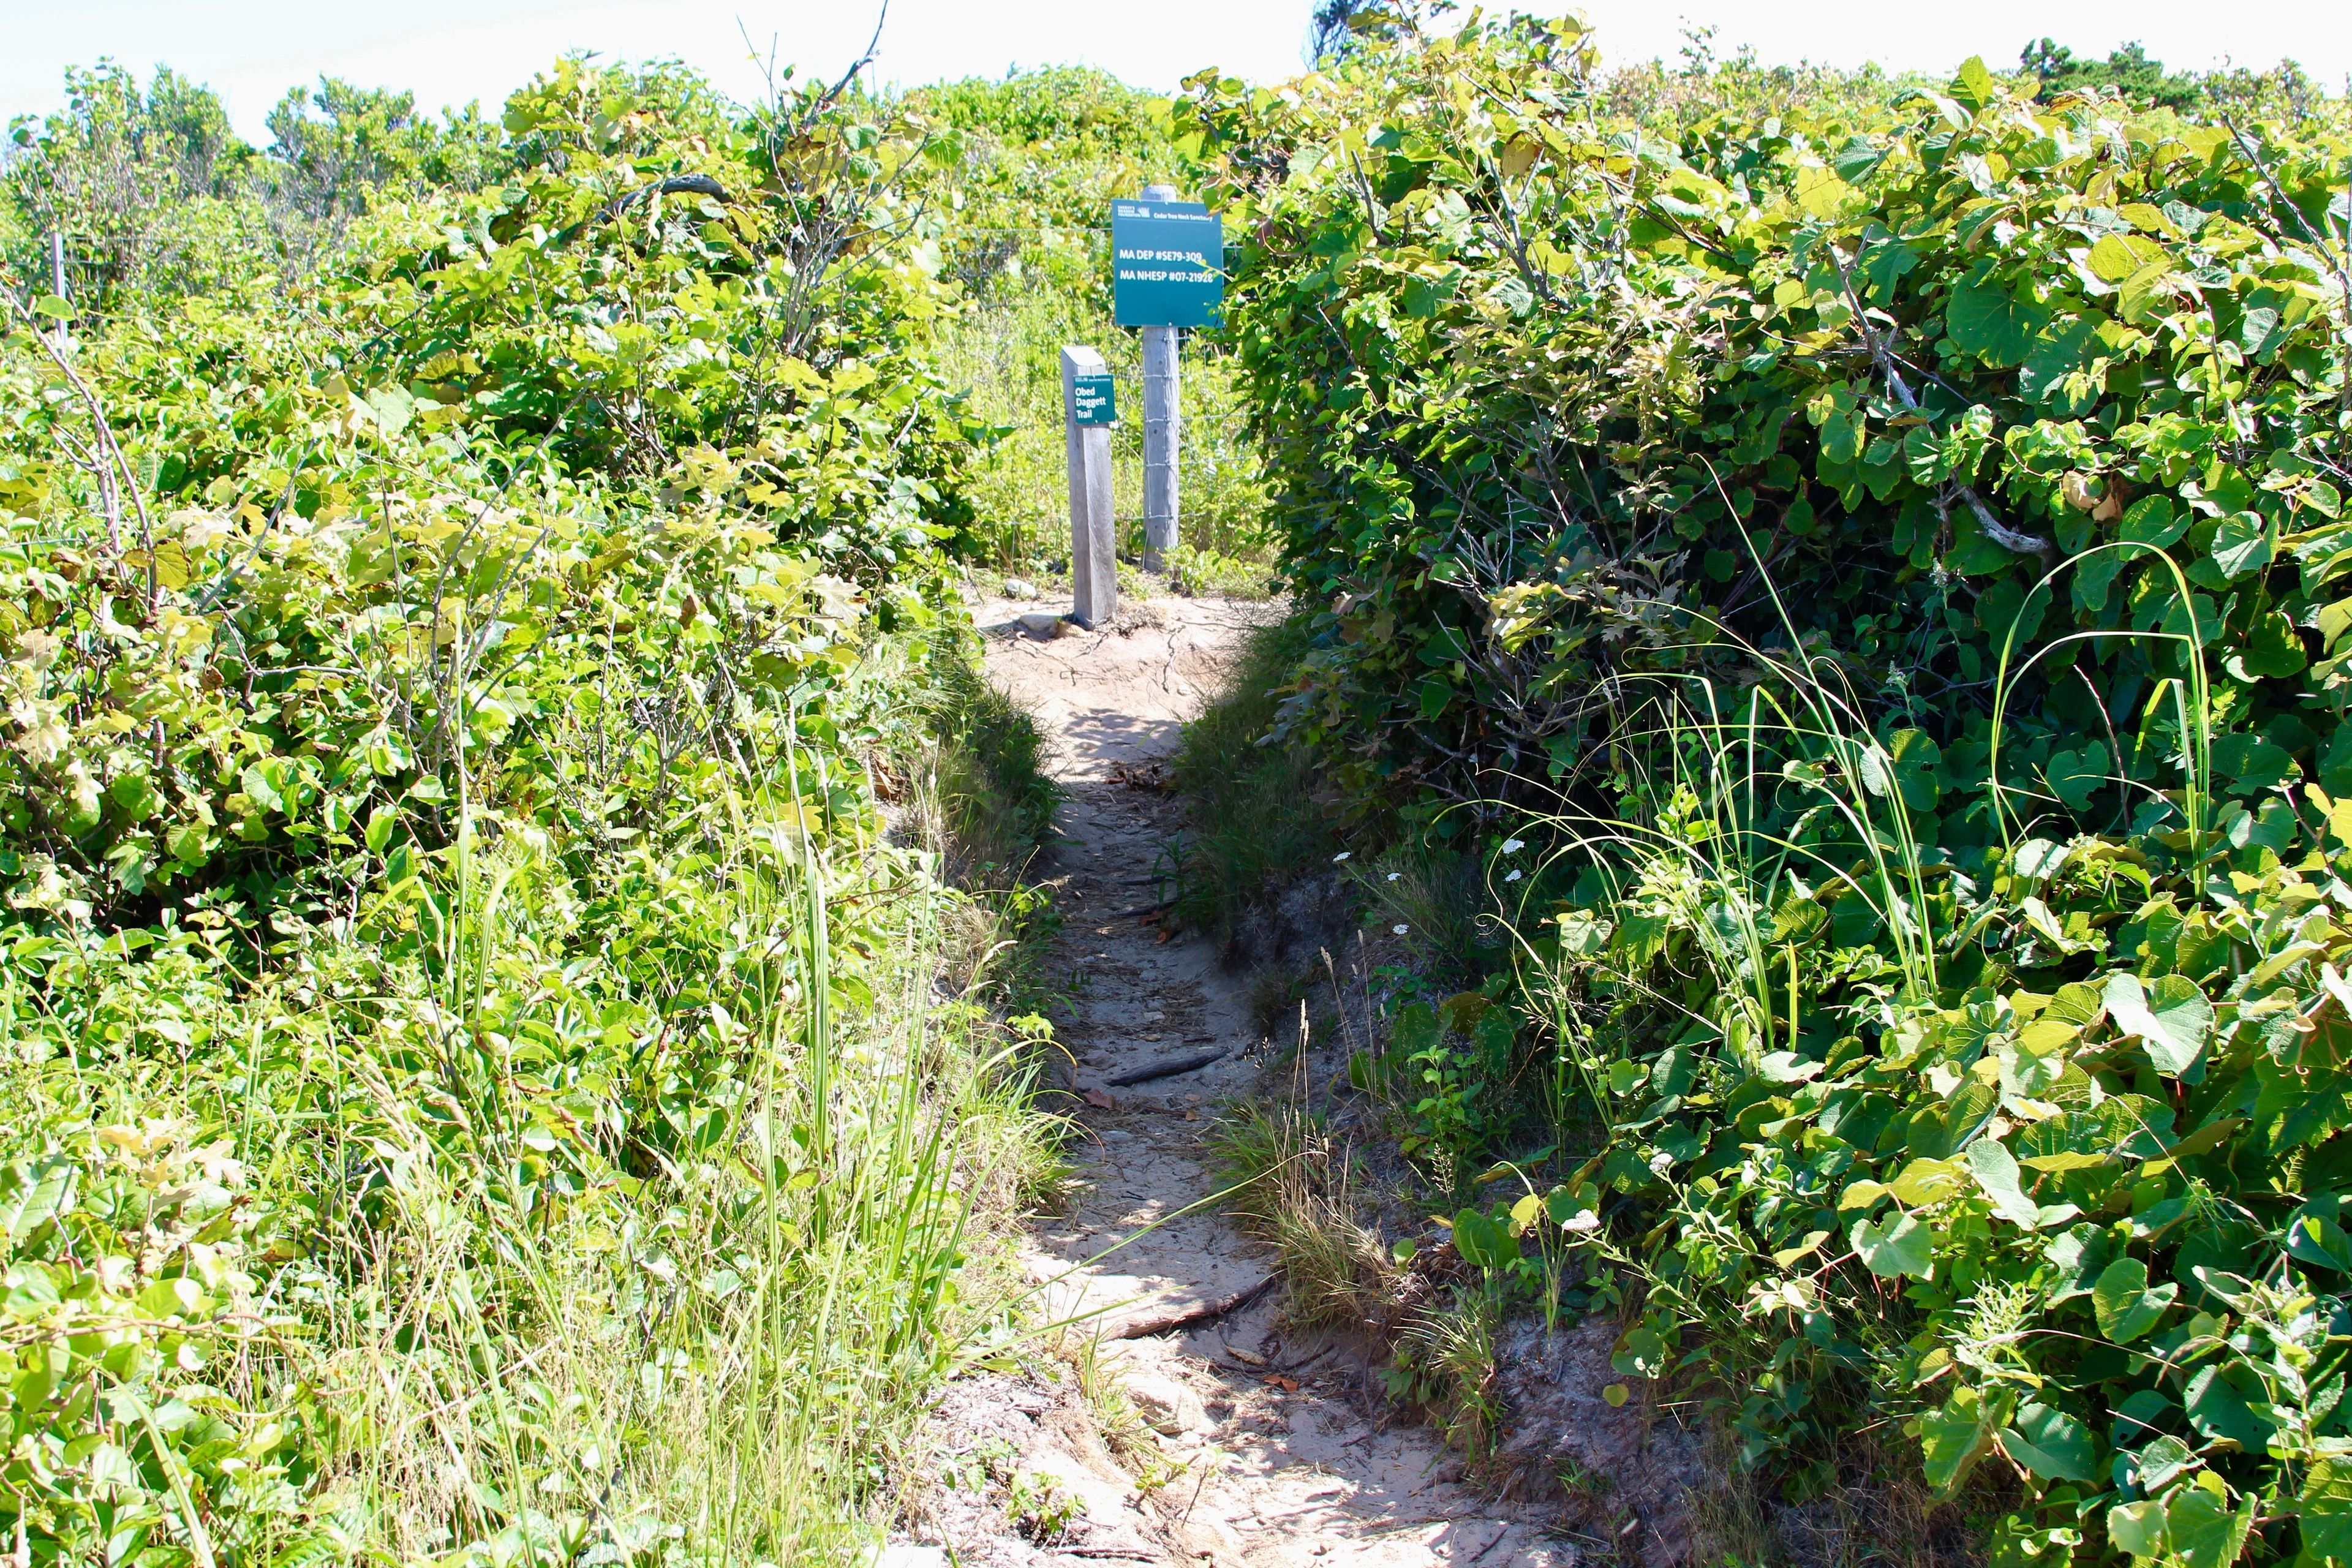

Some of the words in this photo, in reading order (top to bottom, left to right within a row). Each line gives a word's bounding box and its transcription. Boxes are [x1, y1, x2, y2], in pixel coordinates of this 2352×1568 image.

[1120, 249, 1134, 260] MA
[1136, 250, 1154, 260] DEP
[1156, 251, 1202, 262] #SE79-309
[1120, 270, 1136, 280] MA
[1137, 271, 1167, 281] NHESP
[1075, 386, 1095, 397] Obed
[1076, 396, 1106, 409] Daggett
[1076, 409, 1092, 419] Trail
